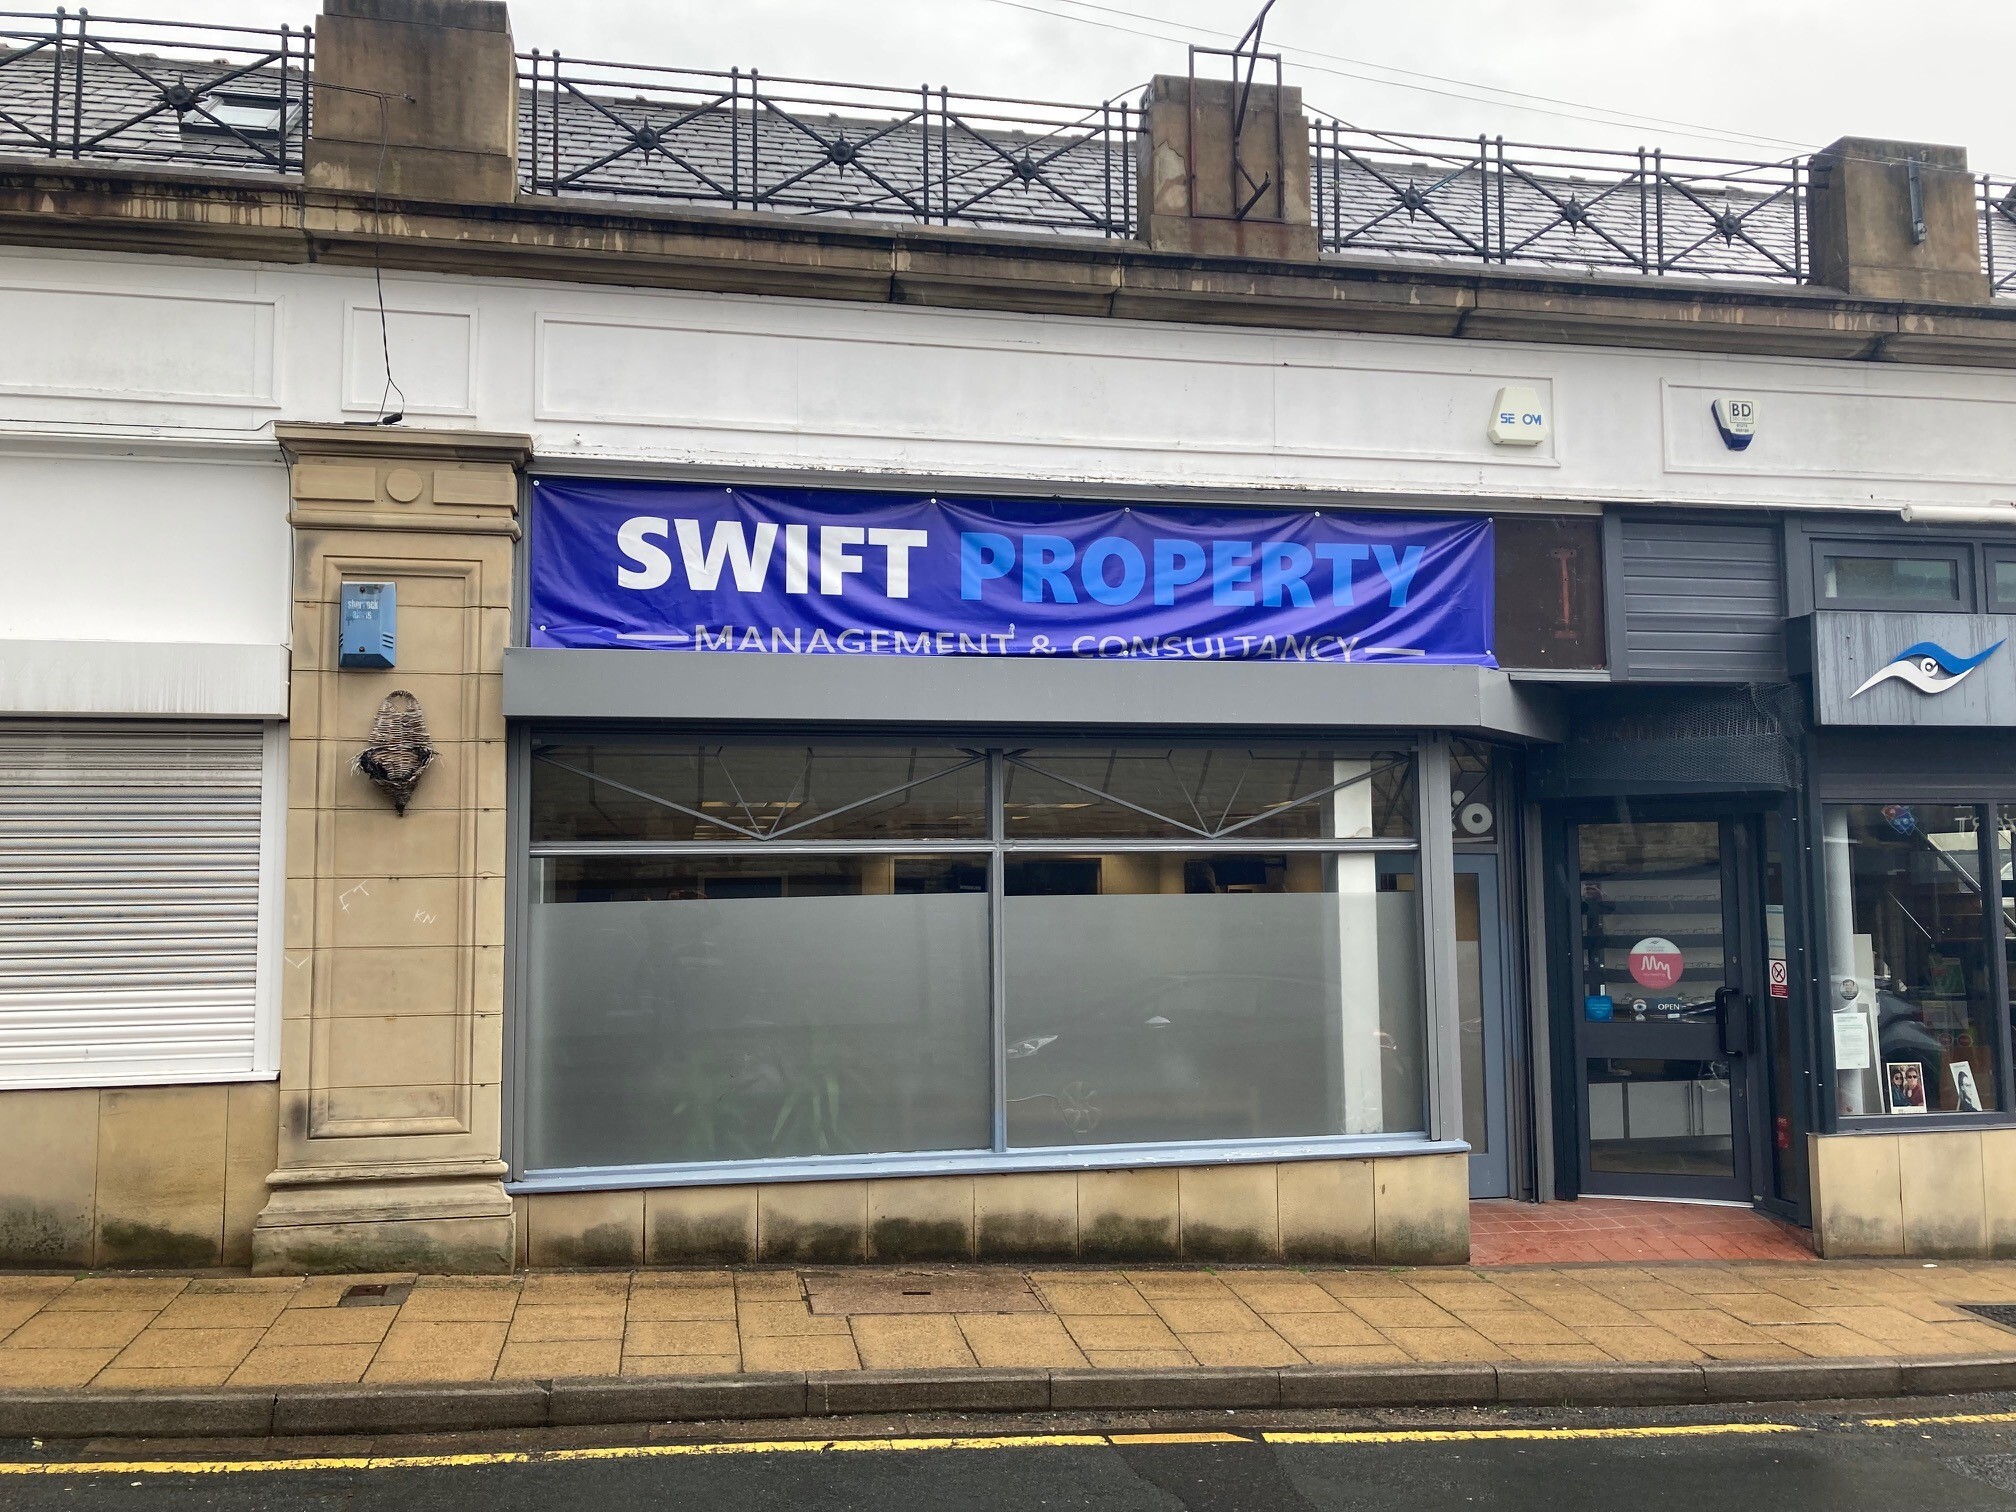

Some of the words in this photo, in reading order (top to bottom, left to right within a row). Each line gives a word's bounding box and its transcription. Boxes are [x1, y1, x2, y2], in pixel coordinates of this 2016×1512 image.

[1732, 403, 1751, 417] BD
[617, 516, 928, 599] SWIFT
[960, 532, 1426, 608] PROPERTY
[695, 624, 1014, 655] MANAGEMENT
[1029, 634, 1057, 655] &
[1072, 635, 1359, 662] CONSULTANCY
[1657, 1003, 1680, 1011] OPEN
